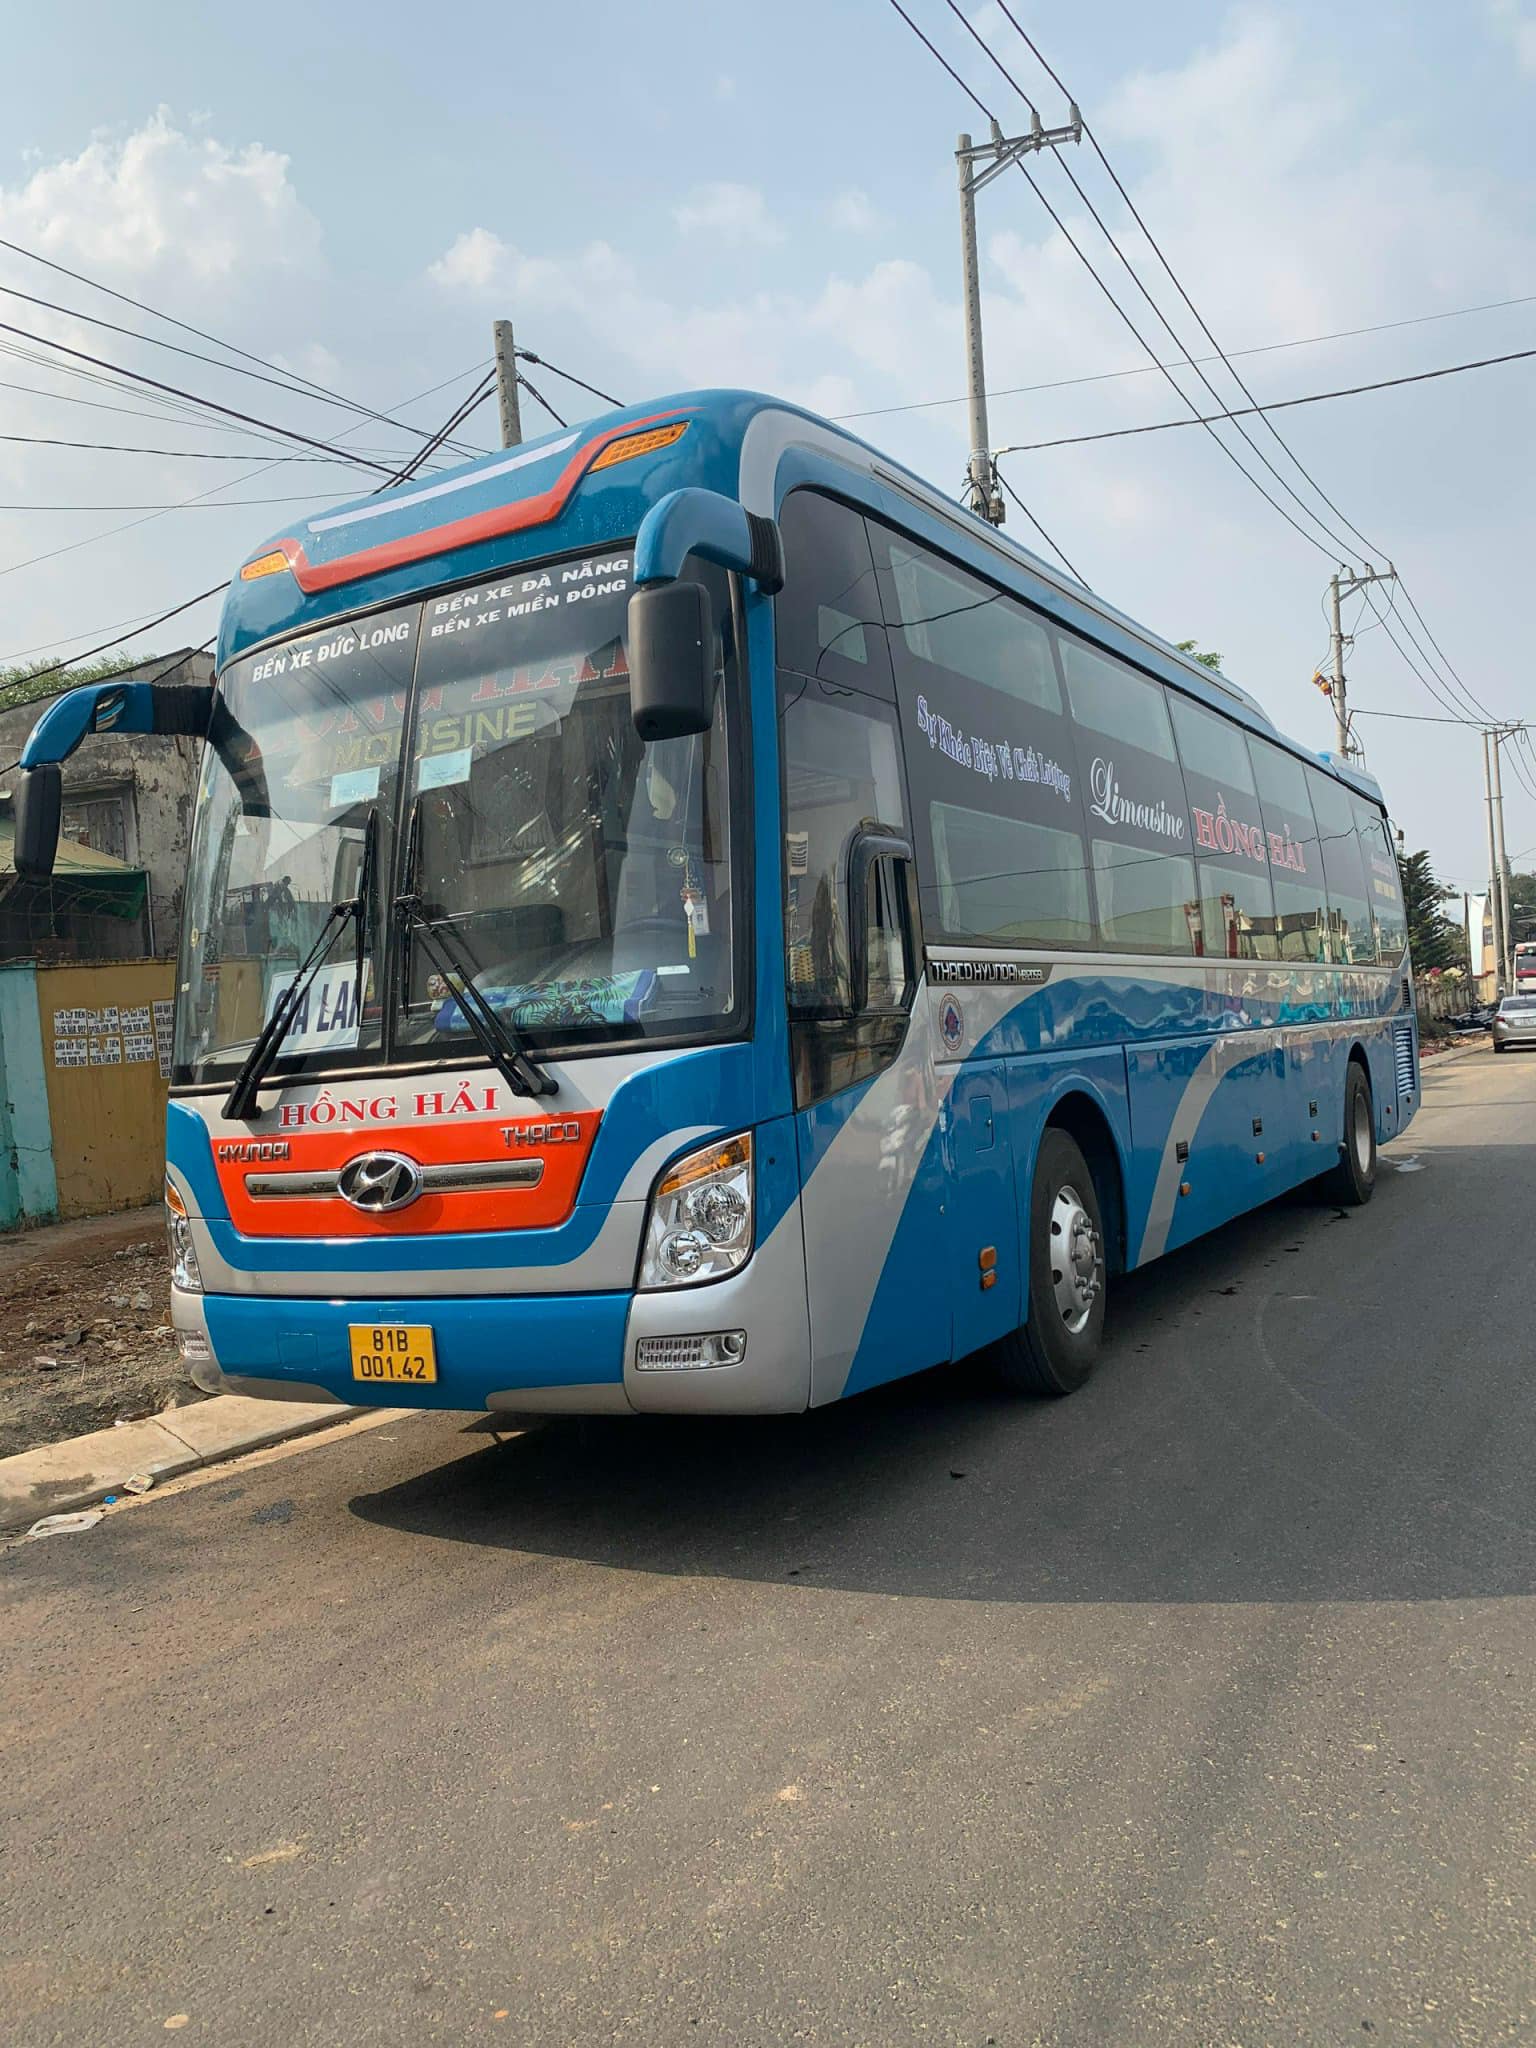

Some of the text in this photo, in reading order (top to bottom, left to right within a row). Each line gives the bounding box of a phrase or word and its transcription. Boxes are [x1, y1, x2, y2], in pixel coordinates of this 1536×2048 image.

[431, 579, 626, 637] BẾN XE MIỀN ĐÔNG
[434, 559, 629, 615] BẾN XE ĐÀ NẴNG
[252, 623, 410, 682] BẾN XE ĐỨC LONG
[917, 695, 937, 749] Sự
[937, 715, 972, 768] Khác
[1089, 757, 1184, 840] Limousine
[1192, 792, 1307, 873] HỒNG HẢI
[932, 962, 972, 980] THACO
[974, 963, 1017, 981] HYUNDAI
[280, 1080, 500, 1127] HỒNG HẢI
[218, 1142, 290, 1163] HYUNDAI
[500, 1122, 579, 1146] THACO
[373, 1329, 408, 1352] 81B
[360, 1355, 426, 1379] 001.42
